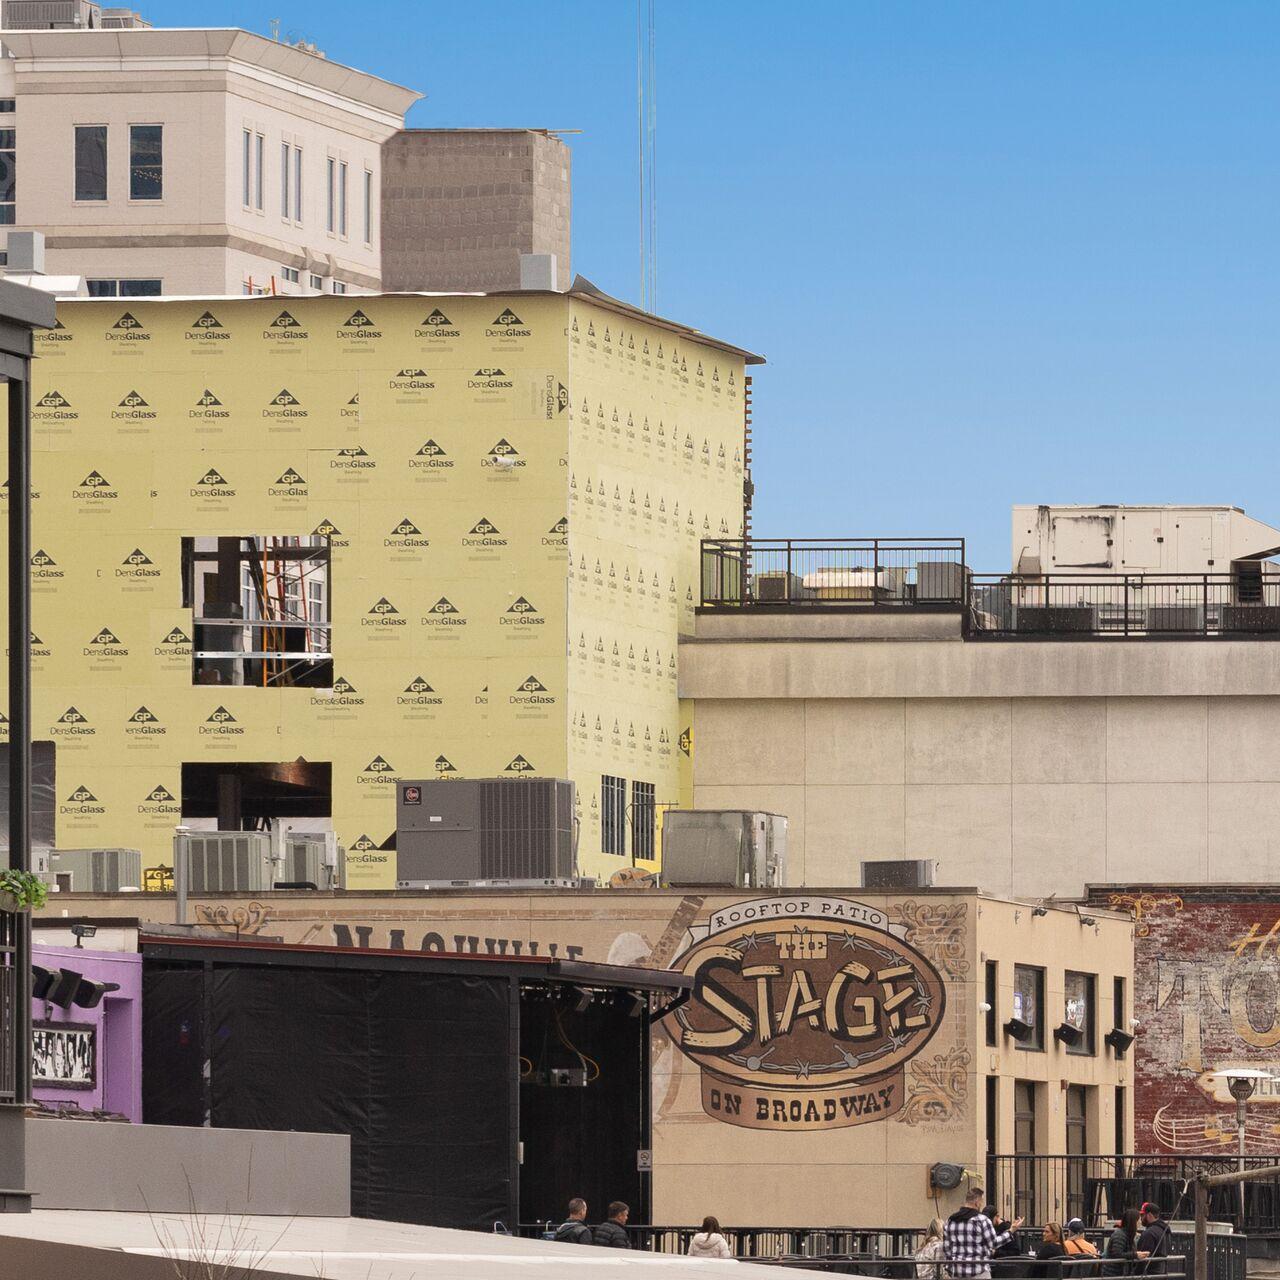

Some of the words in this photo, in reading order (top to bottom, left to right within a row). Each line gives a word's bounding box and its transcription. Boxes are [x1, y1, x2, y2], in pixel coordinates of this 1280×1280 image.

[105, 332, 150, 341] DensGlass
[263, 331, 308, 340] DensGlass
[414, 329, 460, 338] DensGlass
[262, 409, 308, 418] DensGlass
[72, 490, 118, 499] DensGlass
[383, 538, 429, 547] DensGlass
[115, 568, 160, 577] DensGlass
[83, 647, 128, 656] DensGlass
[509, 696, 555, 704] DensGlass
[60, 805, 105, 814] DensGlass
[714, 901, 811, 928] ROOFTOP
[821, 902, 883, 925] PATIO
[775, 933, 828, 960] THE
[681, 944, 931, 1051] STAGE
[711, 1089, 742, 1115] ON
[756, 1085, 896, 1122] BROADWAY
